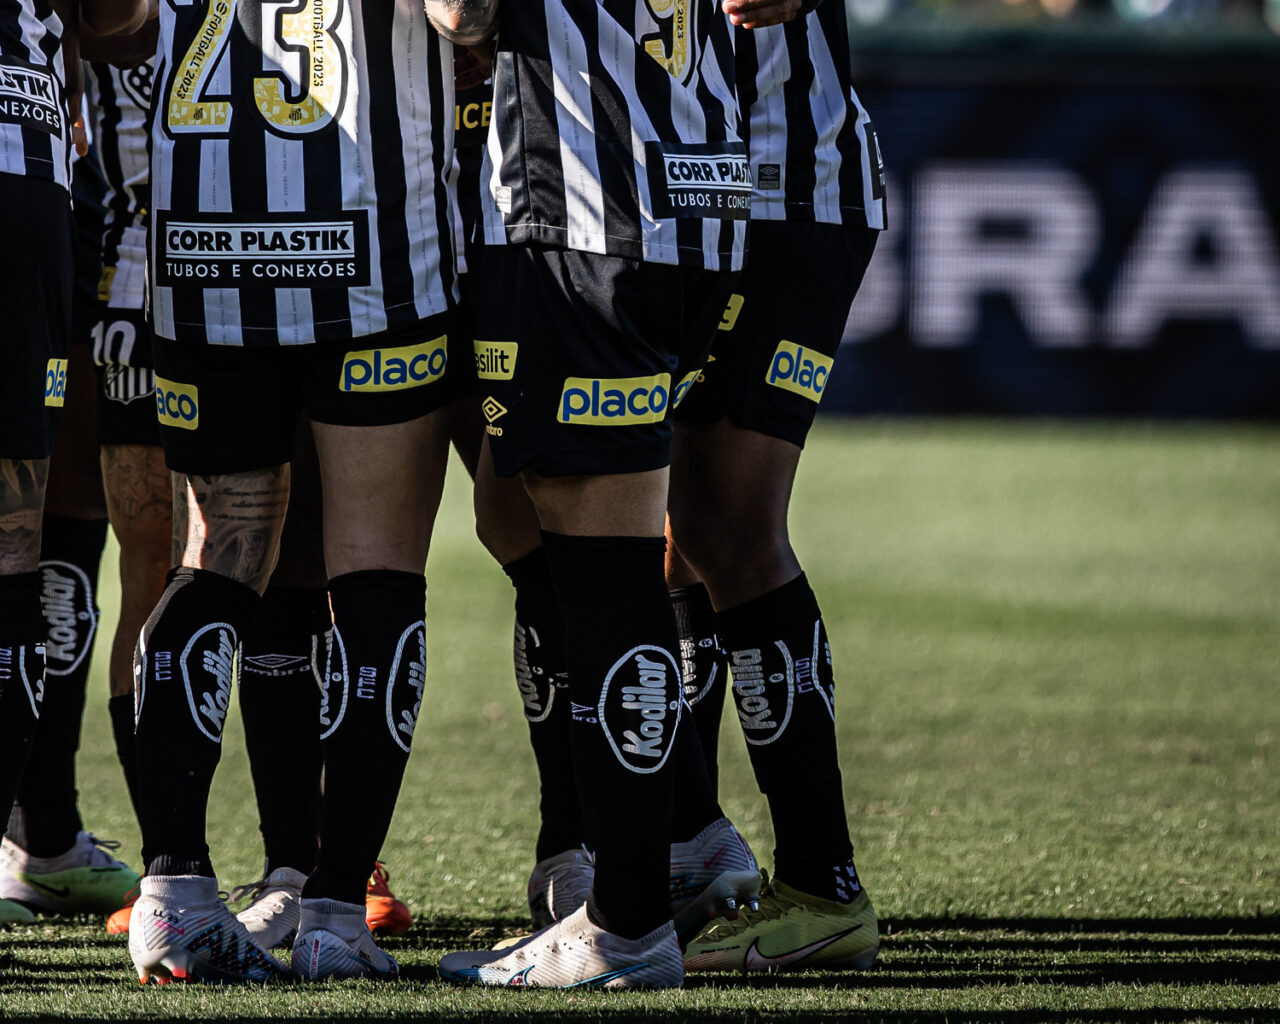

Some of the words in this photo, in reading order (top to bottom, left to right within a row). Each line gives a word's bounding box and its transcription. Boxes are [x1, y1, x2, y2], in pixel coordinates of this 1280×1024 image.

[677, 8, 685, 40] 2023
[176, 69, 195, 100] 2023
[312, 56, 324, 88] 2023
[668, 160, 717, 181] CORR
[668, 193, 711, 207] TUBOS
[717, 195, 723, 207] E
[168, 229, 234, 251] CORR
[240, 229, 351, 251] PLASTIK
[840, 161, 1280, 348] RA
[166, 262, 219, 277] TUBOS
[232, 264, 240, 277] E
[252, 261, 356, 278] CONEXÕES
[91, 320, 136, 367] 10
[344, 348, 447, 391] placo
[562, 379, 668, 422] placo
[40, 568, 79, 662] Kodilar
[621, 654, 667, 758] Kodilar
